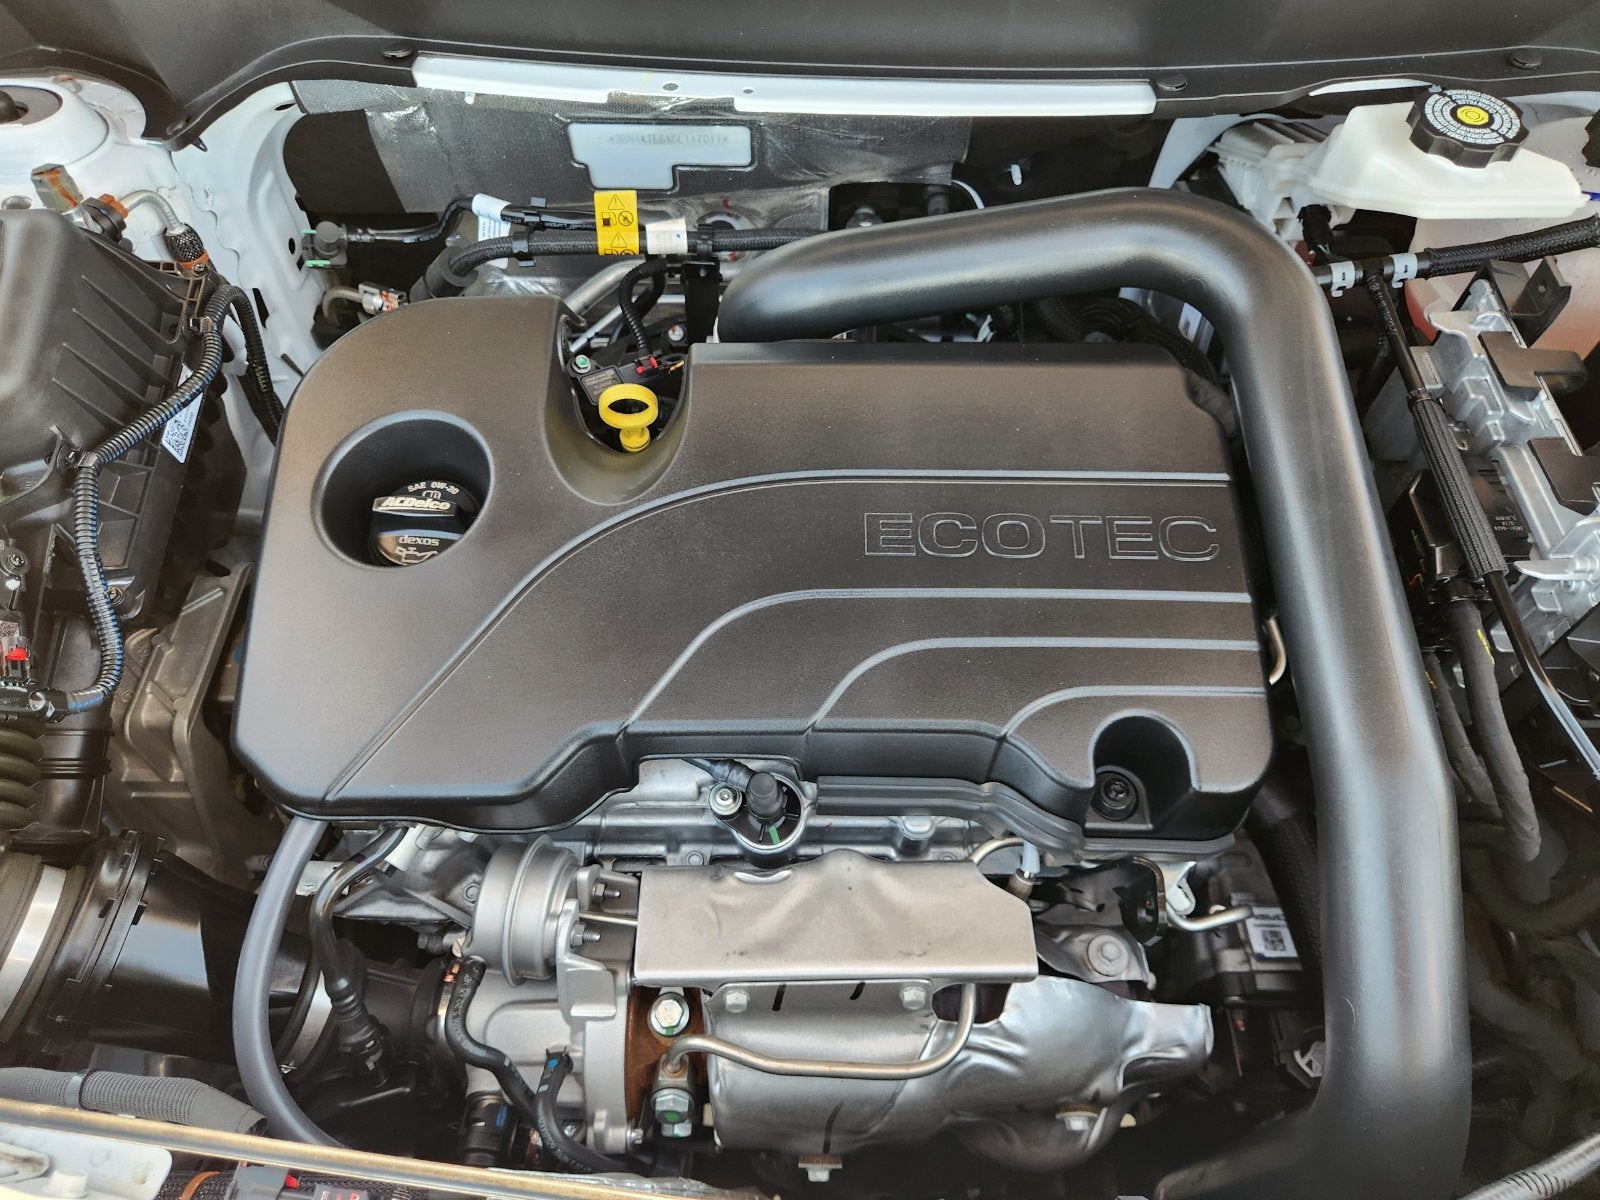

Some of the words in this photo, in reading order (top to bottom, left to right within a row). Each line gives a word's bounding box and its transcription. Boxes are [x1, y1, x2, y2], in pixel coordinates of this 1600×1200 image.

[408, 481, 427, 493] SAE
[381, 496, 451, 511] ACDelco
[398, 535, 441, 547] dexos
[864, 512, 1219, 562] ECOTEC
